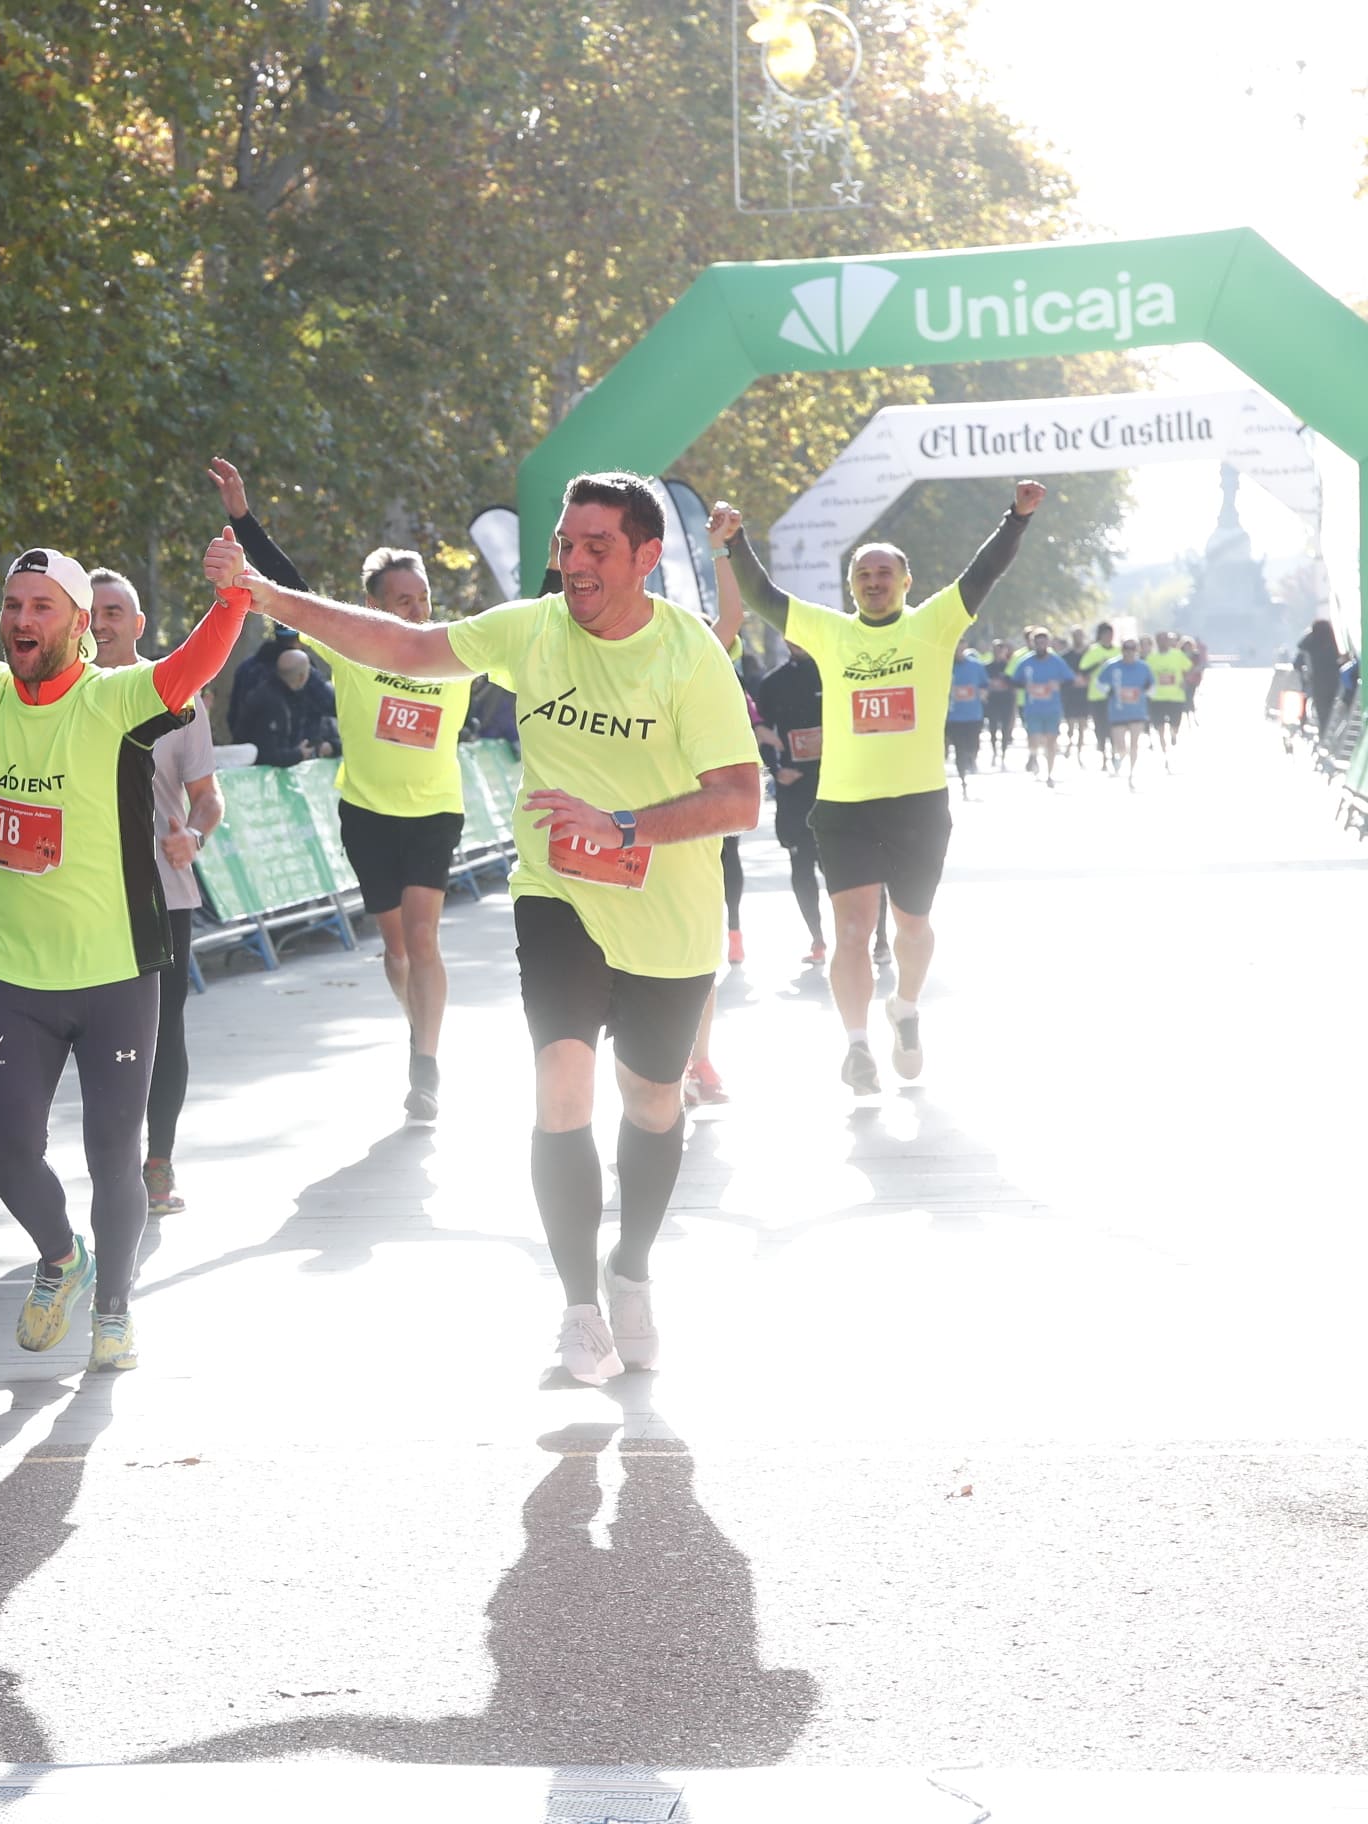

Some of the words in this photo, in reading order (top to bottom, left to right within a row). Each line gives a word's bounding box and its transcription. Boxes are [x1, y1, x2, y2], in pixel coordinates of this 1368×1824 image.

[914, 270, 1176, 342] Unicaja
[919, 424, 959, 459] El
[965, 421, 1047, 457] Norte
[1052, 421, 1084, 451] de
[1090, 409, 1214, 450] Castilla
[842, 661, 914, 681] MICHELIN
[373, 674, 443, 696] MICHELIN
[385, 705, 420, 731] 792
[520, 686, 657, 741] ADIENT
[858, 696, 890, 719] 791
